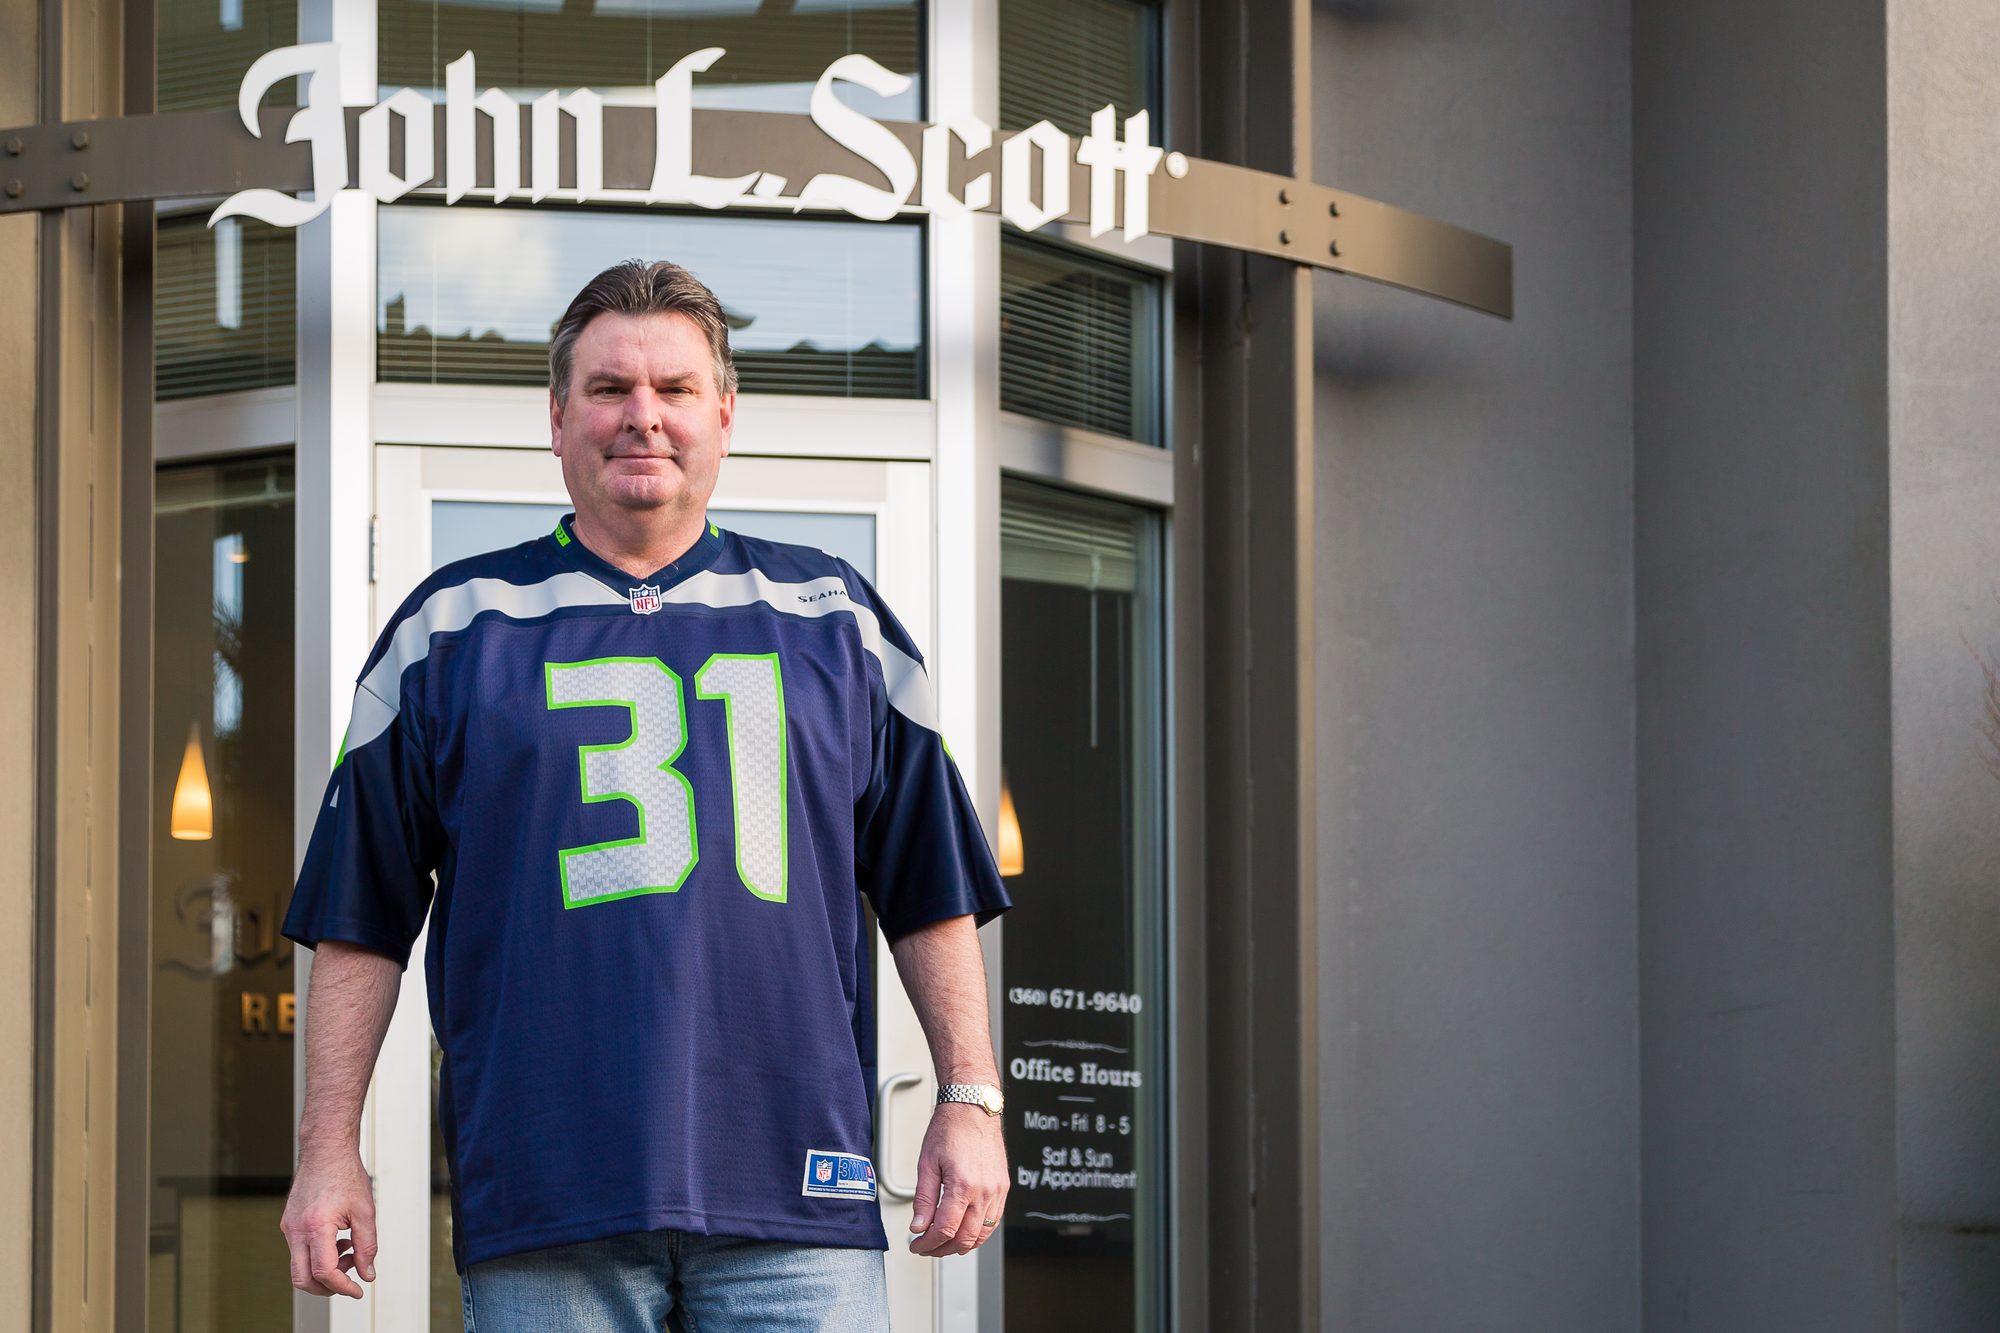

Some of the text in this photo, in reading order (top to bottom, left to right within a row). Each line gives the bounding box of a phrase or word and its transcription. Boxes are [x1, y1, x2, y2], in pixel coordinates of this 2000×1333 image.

[207, 42, 1164, 243] John L. Scott
[635, 597, 658, 610] NFL
[544, 652, 787, 910] 31
[1009, 987, 1142, 1014] (360) 671-9640
[1010, 1057, 1142, 1088] Office Hours
[1024, 1110, 1060, 1131] Mon
[1071, 1112, 1089, 1132] Fri
[1095, 1114, 1106, 1134] 8
[1119, 1115, 1131, 1136] 5
[1042, 1145, 1114, 1169] Sat & Sun
[1017, 1165, 1137, 1191] by Appointment
